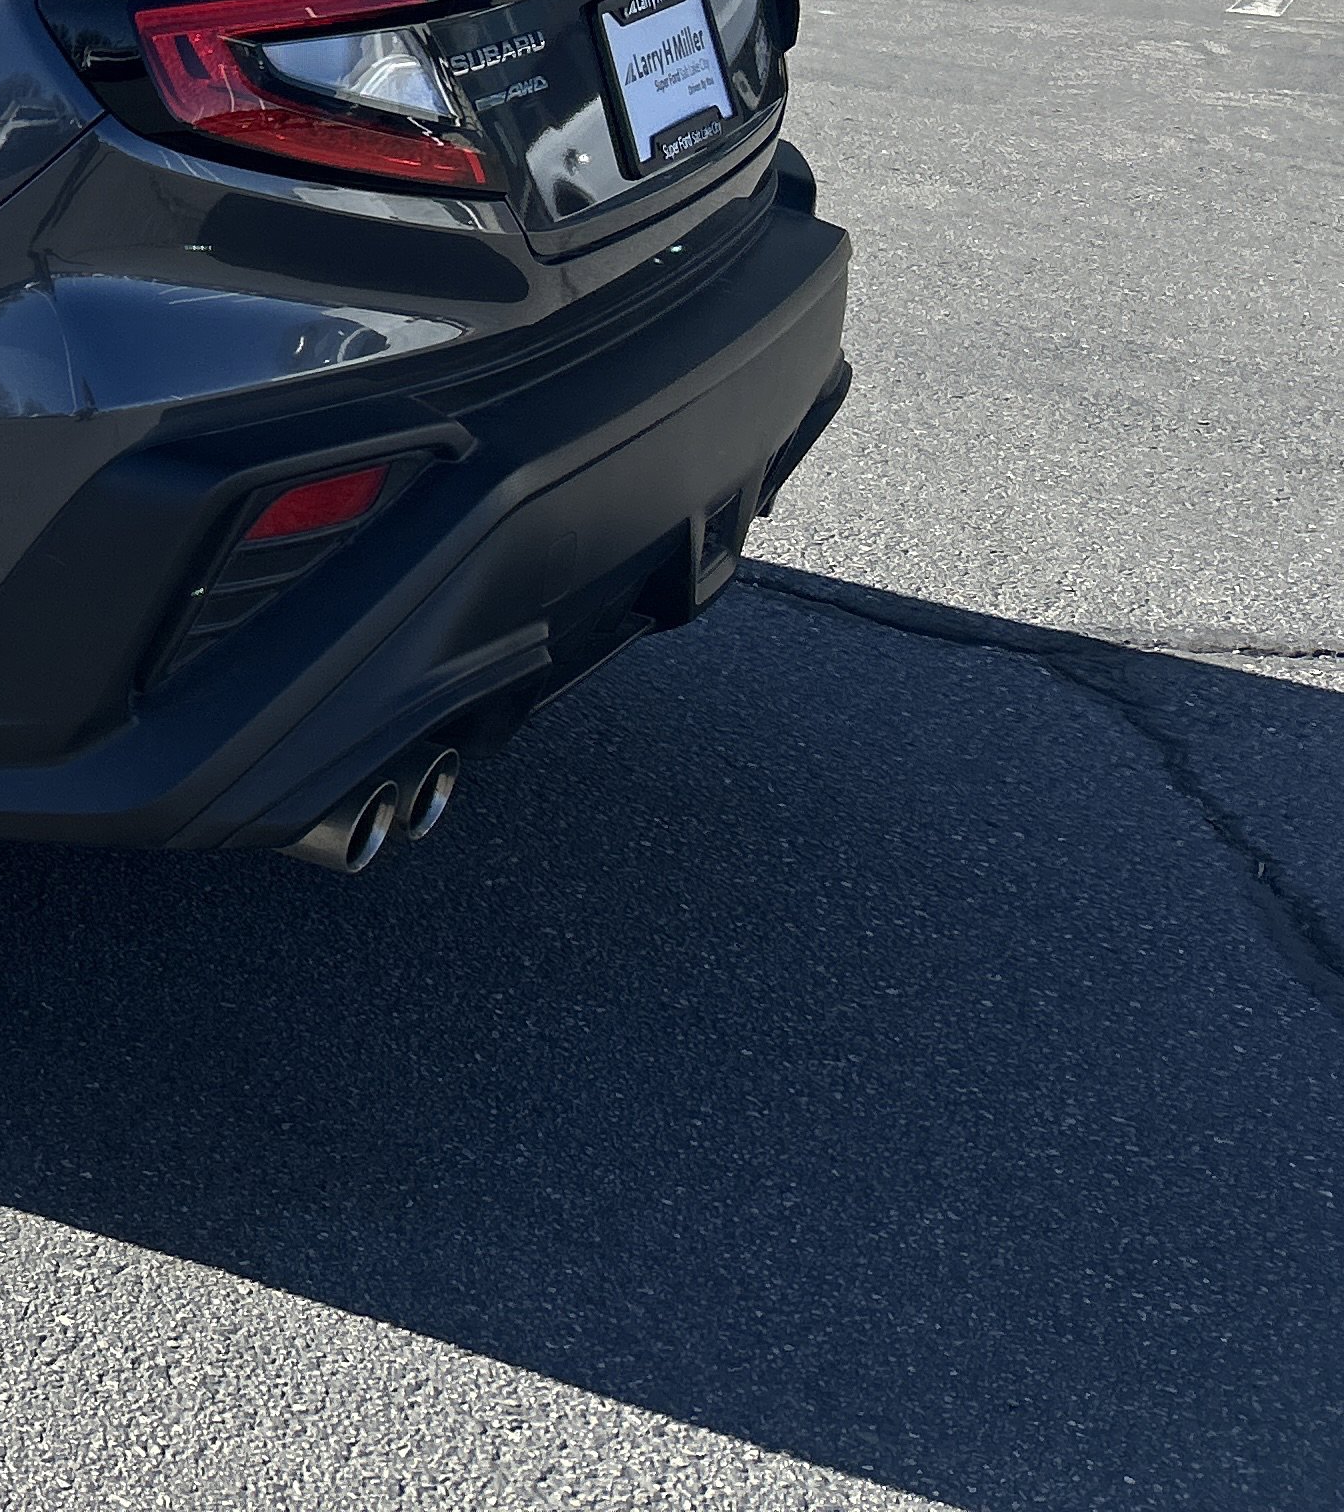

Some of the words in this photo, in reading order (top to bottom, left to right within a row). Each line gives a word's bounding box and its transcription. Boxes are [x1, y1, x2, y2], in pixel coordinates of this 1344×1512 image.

[450, 31, 546, 76] SUBARU
[632, 48, 664, 78] Larry
[662, 38, 675, 65] H
[672, 25, 705, 61] Miller
[505, 75, 549, 103] AWD
